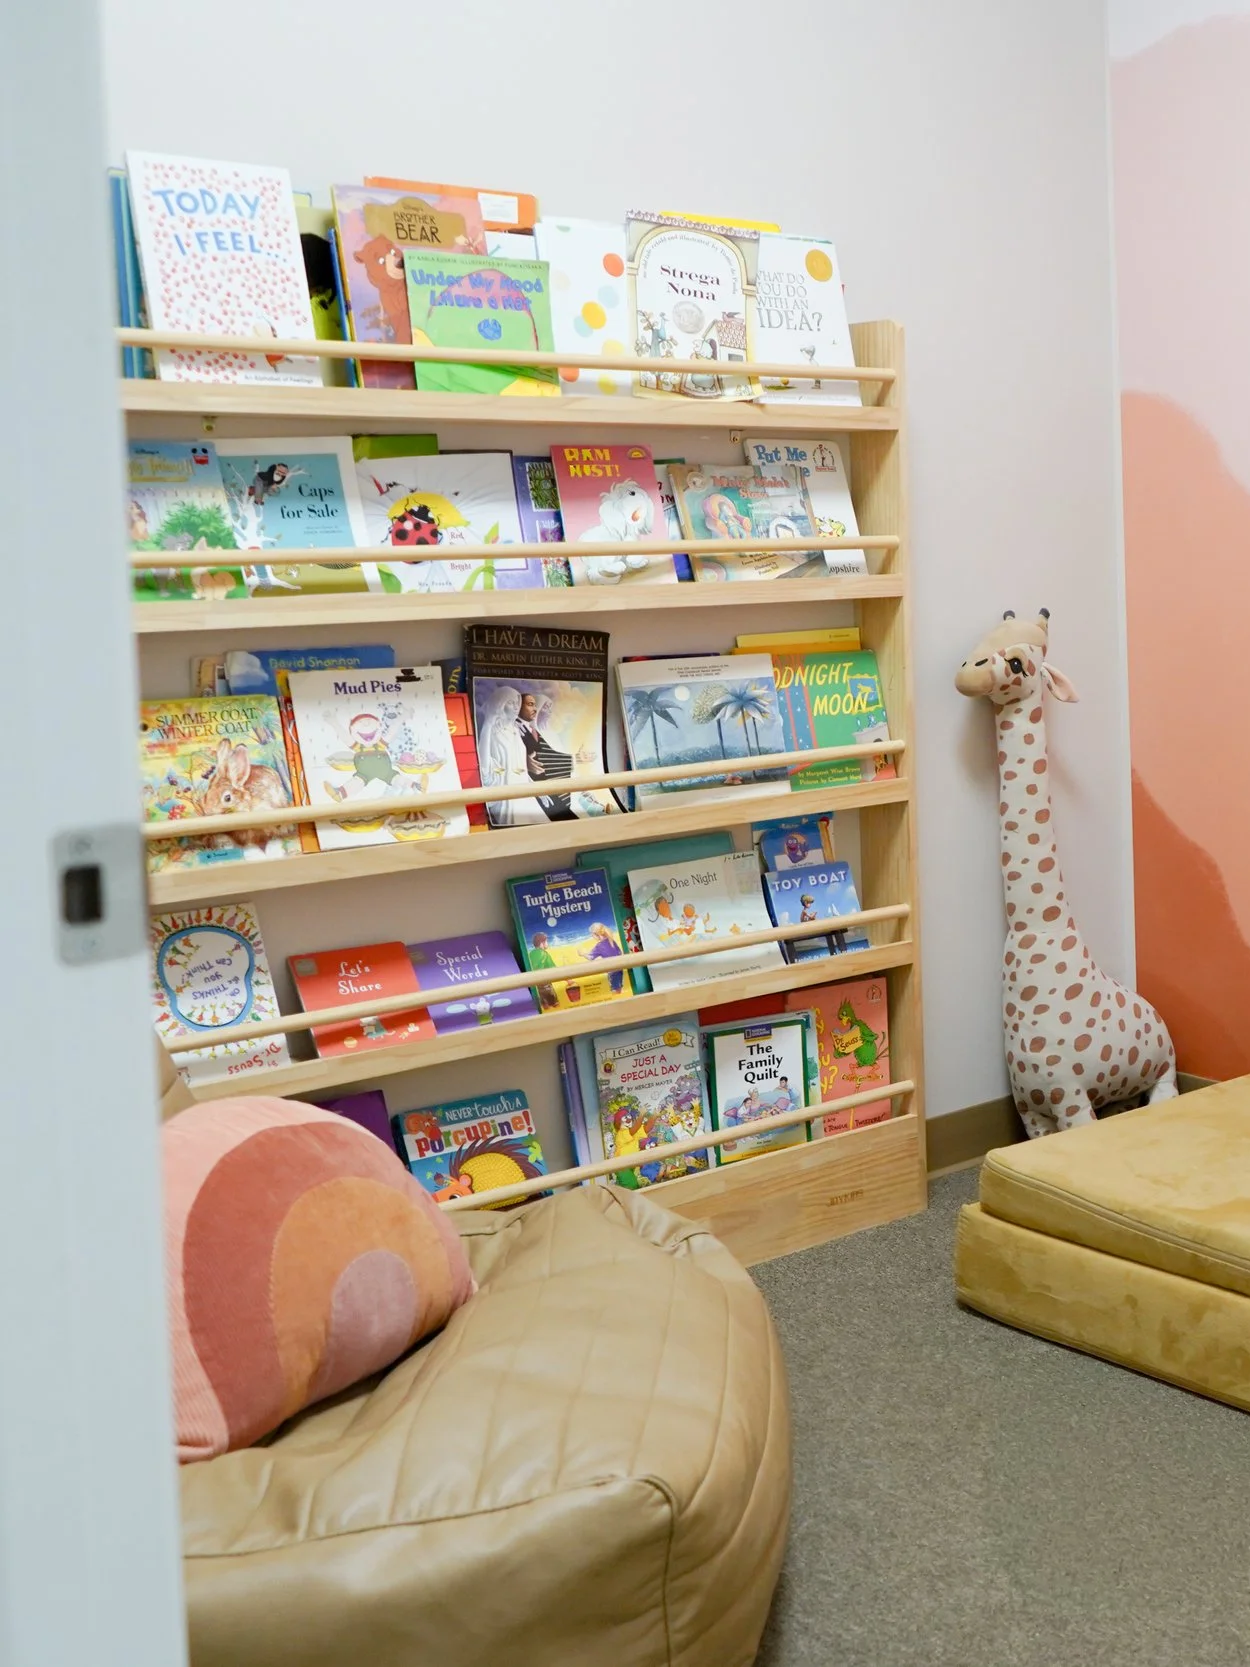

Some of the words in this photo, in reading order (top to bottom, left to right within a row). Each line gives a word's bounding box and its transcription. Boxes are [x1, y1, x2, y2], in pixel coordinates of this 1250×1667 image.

[152, 189, 260, 219] TODAY
[393, 211, 436, 225] BROTHER
[395, 222, 442, 244] BEAR
[174, 234, 187, 256] I
[410, 269, 463, 287] Under
[468, 273, 495, 292] My
[660, 264, 721, 286] Strega
[786, 273, 805, 285] DO
[667, 281, 717, 301] Nona
[786, 285, 808, 299] DO
[755, 295, 789, 309] WITH
[792, 299, 809, 311] AN
[756, 307, 823, 332] IDEA?
[753, 444, 782, 463] Put
[784, 446, 808, 462] Me
[298, 483, 335, 502] Caps
[280, 505, 303, 519] for
[307, 503, 339, 518] Sale
[450, 562, 472, 572] Bright
[829, 563, 860, 574] opshire
[472, 628, 477, 644] I
[485, 629, 527, 647] HAVE
[532, 632, 542, 648] A
[548, 632, 604, 651] DREAM
[269, 657, 306, 668] David
[308, 656, 361, 668] Shannon
[491, 652, 527, 664] MARTIN
[530, 655, 564, 666] LUTHER
[334, 681, 367, 695] Mud
[370, 680, 402, 694] Pies
[813, 691, 869, 717] MOON
[156, 711, 219, 727] SUMMER
[157, 724, 216, 739] WINTER
[216, 721, 252, 735] COAT
[670, 878, 690, 890] One
[690, 872, 718, 886] Night
[772, 878, 802, 893] TOY
[808, 870, 846, 886] BOAT
[523, 891, 561, 907] Turtle
[562, 882, 602, 900] Beach
[540, 901, 592, 918] Mystery
[436, 945, 483, 967] Special
[338, 960, 370, 978] Let's
[442, 964, 488, 982] Words
[338, 980, 382, 995] Share
[260, 1042, 282, 1057] Dr.
[618, 1048, 635, 1056] Can
[636, 1038, 661, 1050] Read!
[746, 1043, 773, 1056] The
[227, 1054, 264, 1075] Seuss
[632, 1055, 657, 1068] JUST
[659, 1054, 668, 1063] A
[738, 1054, 784, 1071] Family
[620, 1068, 659, 1084] SPECIAL
[661, 1063, 682, 1076] DAY
[744, 1068, 779, 1084] Quilt
[634, 1082, 655, 1092] MERCER
[655, 1079, 673, 1087] MAYER
[445, 1108, 472, 1122] NEVER
[472, 1096, 516, 1118] touch
